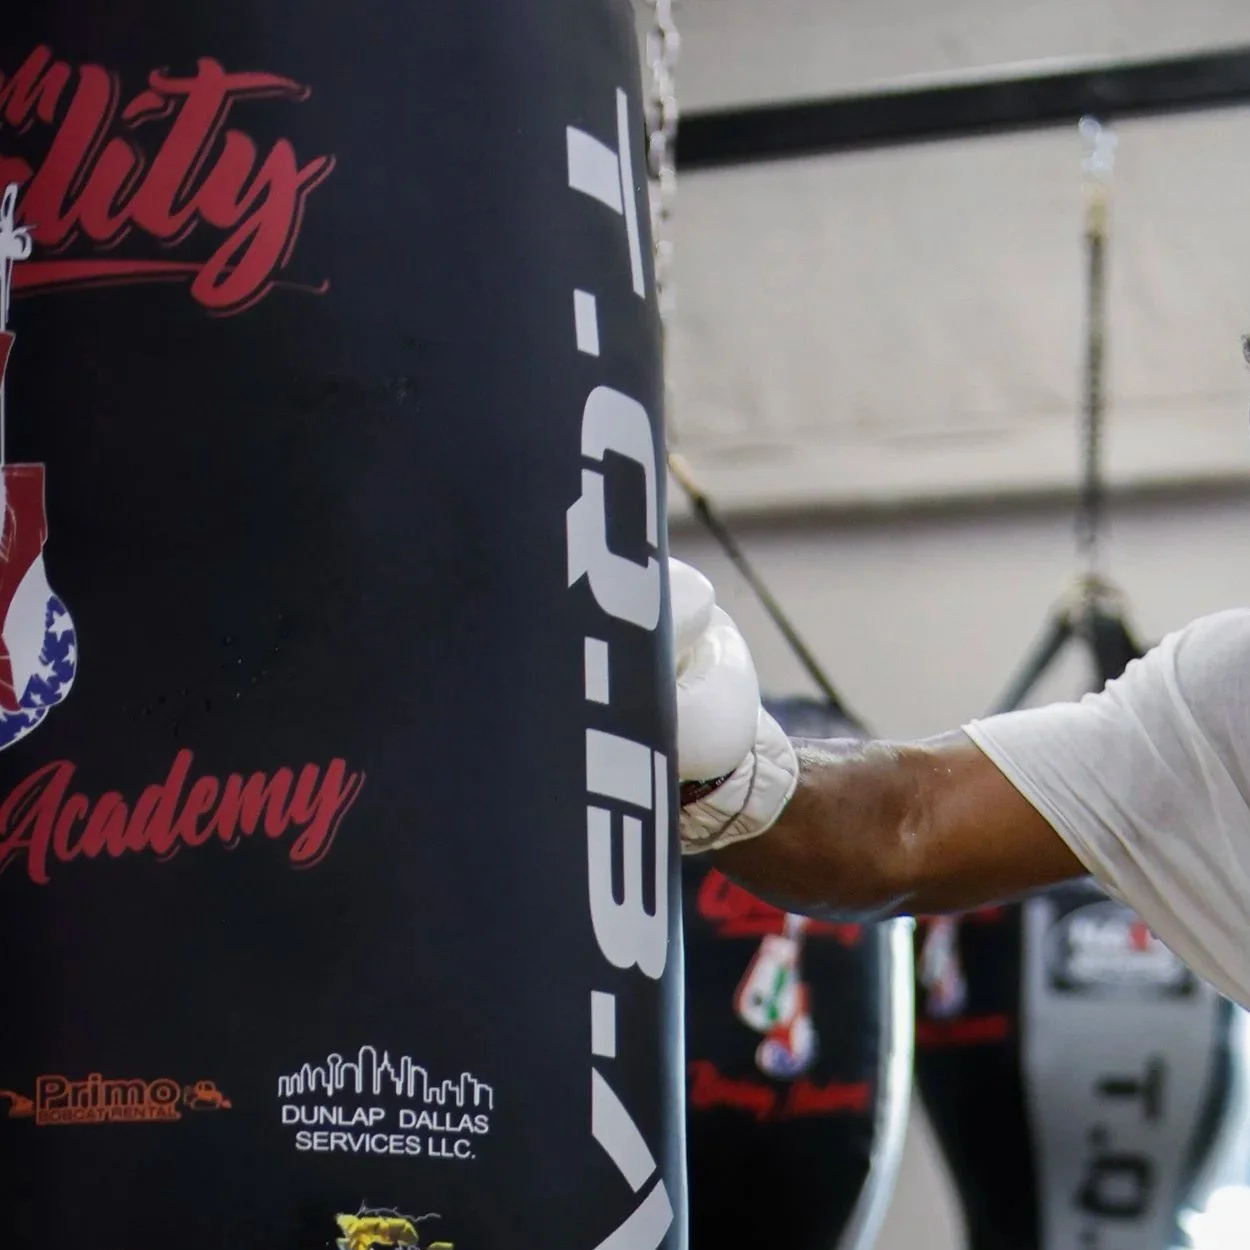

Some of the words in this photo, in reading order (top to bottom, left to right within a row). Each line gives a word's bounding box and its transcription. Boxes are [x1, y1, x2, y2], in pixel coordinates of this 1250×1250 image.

[0, 749, 365, 885] Academy
[36, 1073, 181, 1108] Primo
[281, 1104, 385, 1127] DUNLAP
[399, 1109, 489, 1134] DALLAS
[295, 1130, 421, 1155] SERVICES
[428, 1138, 476, 1160] LLC.
